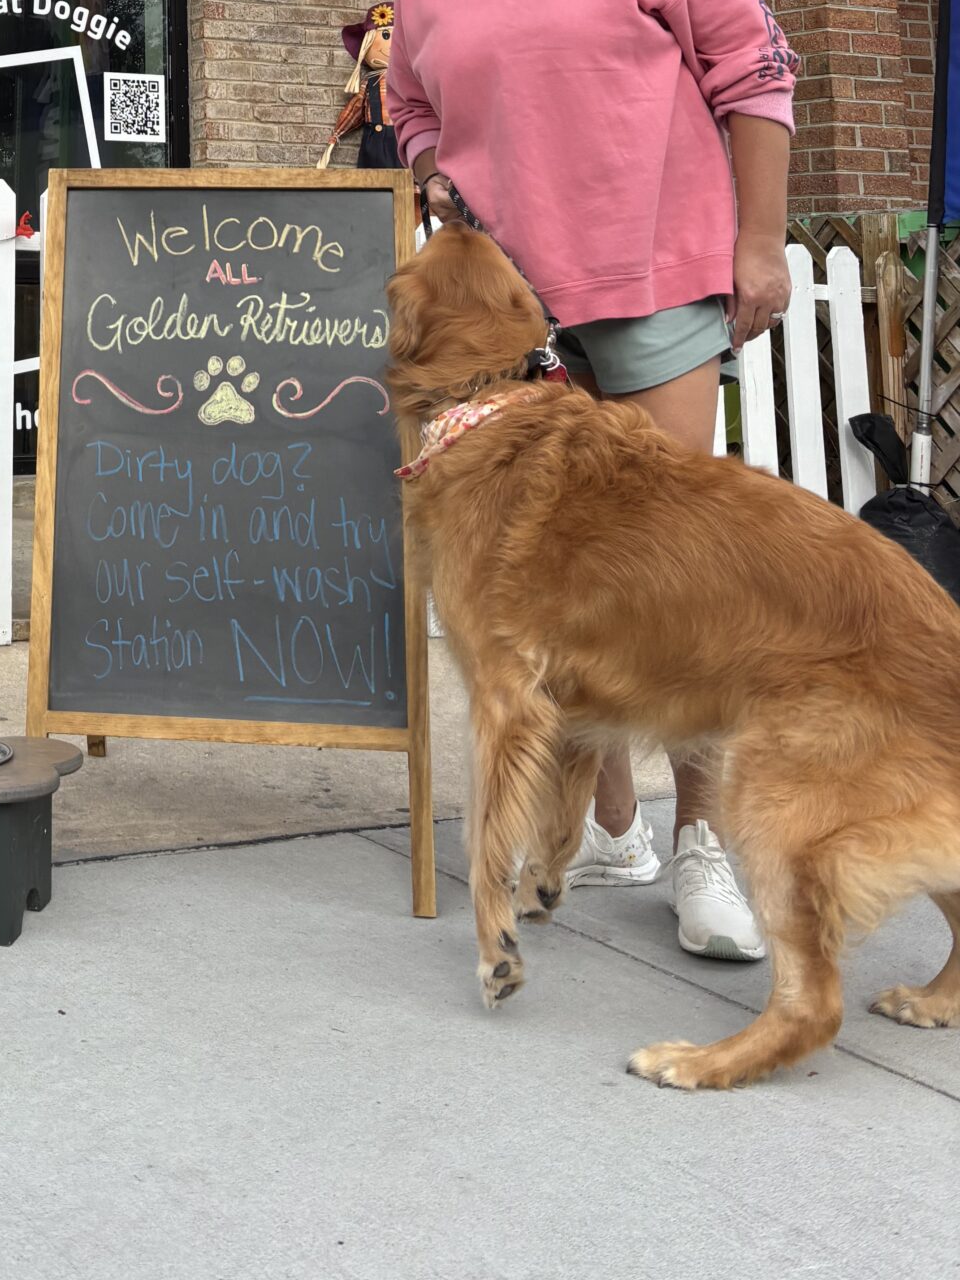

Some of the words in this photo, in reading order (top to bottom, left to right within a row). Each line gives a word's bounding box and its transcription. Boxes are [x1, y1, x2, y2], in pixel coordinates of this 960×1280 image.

[117, 204, 344, 273] Welcome
[205, 258, 259, 286] ALL
[87, 293, 234, 354] Golden
[236, 291, 390, 348] Retrievers
[86, 440, 192, 518] Dirty
[212, 441, 313, 500] dog?
[87, 491, 180, 549] Come
[199, 494, 229, 543] in
[248, 497, 321, 551] and
[331, 497, 397, 590] try
[96, 558, 152, 607] our
[230, 612, 396, 701] NOW!
